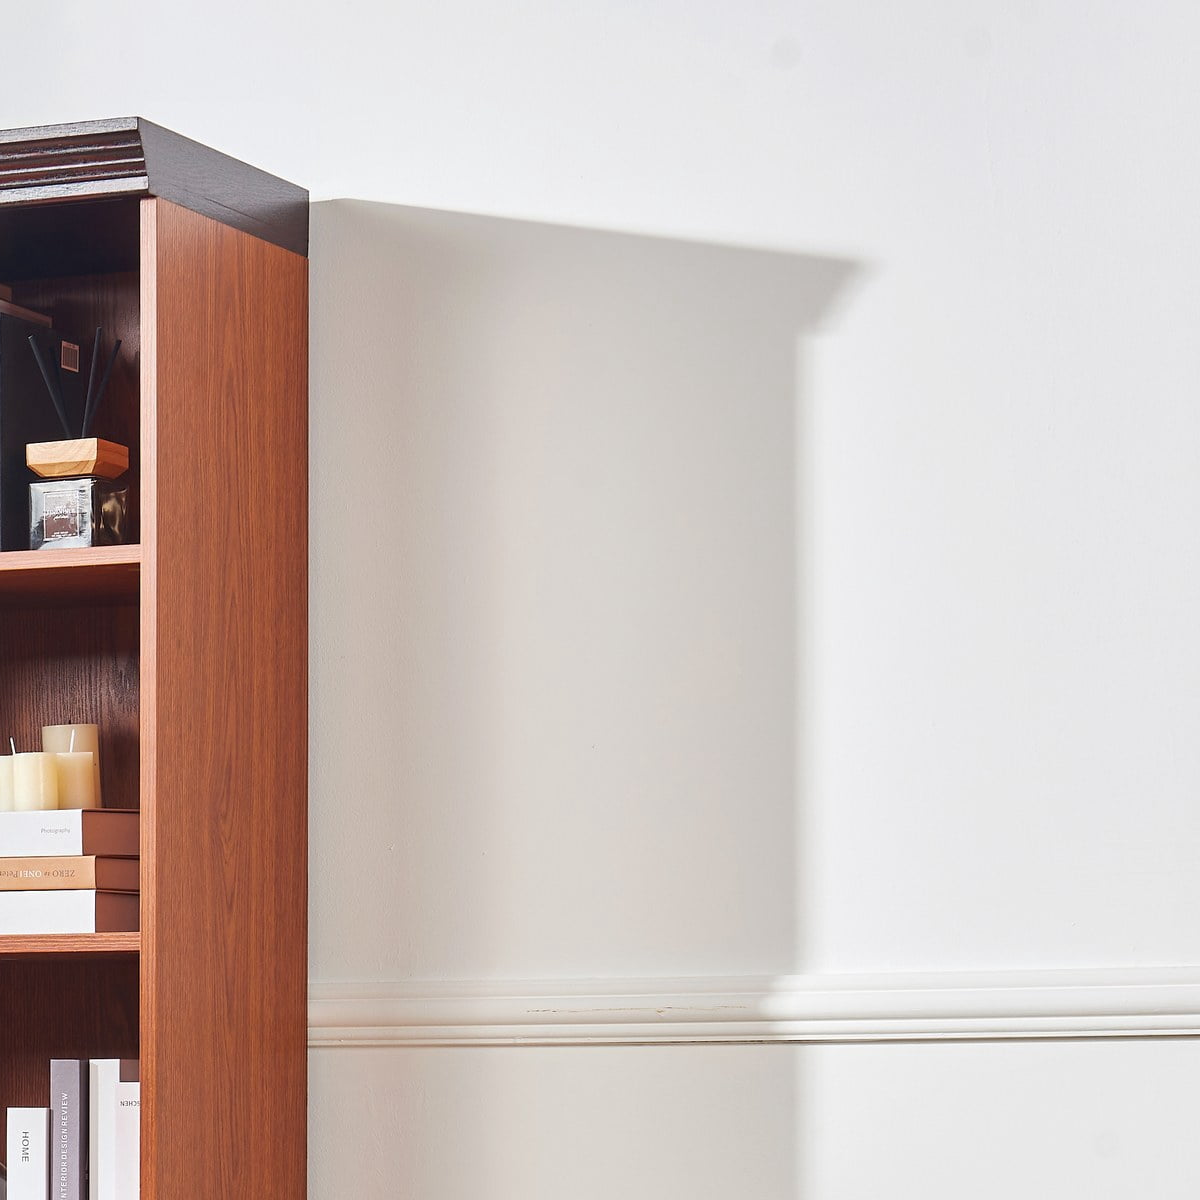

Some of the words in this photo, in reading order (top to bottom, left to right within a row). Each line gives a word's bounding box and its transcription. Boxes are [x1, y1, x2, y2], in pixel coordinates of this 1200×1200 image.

[0, 870, 18, 878] Peter
[23, 870, 42, 878] ONE
[52, 869, 76, 878] ZERO
[60, 1092, 68, 1126] REVIEW
[21, 1131, 30, 1162] HOME
[60, 1128, 68, 1160] DESIGN
